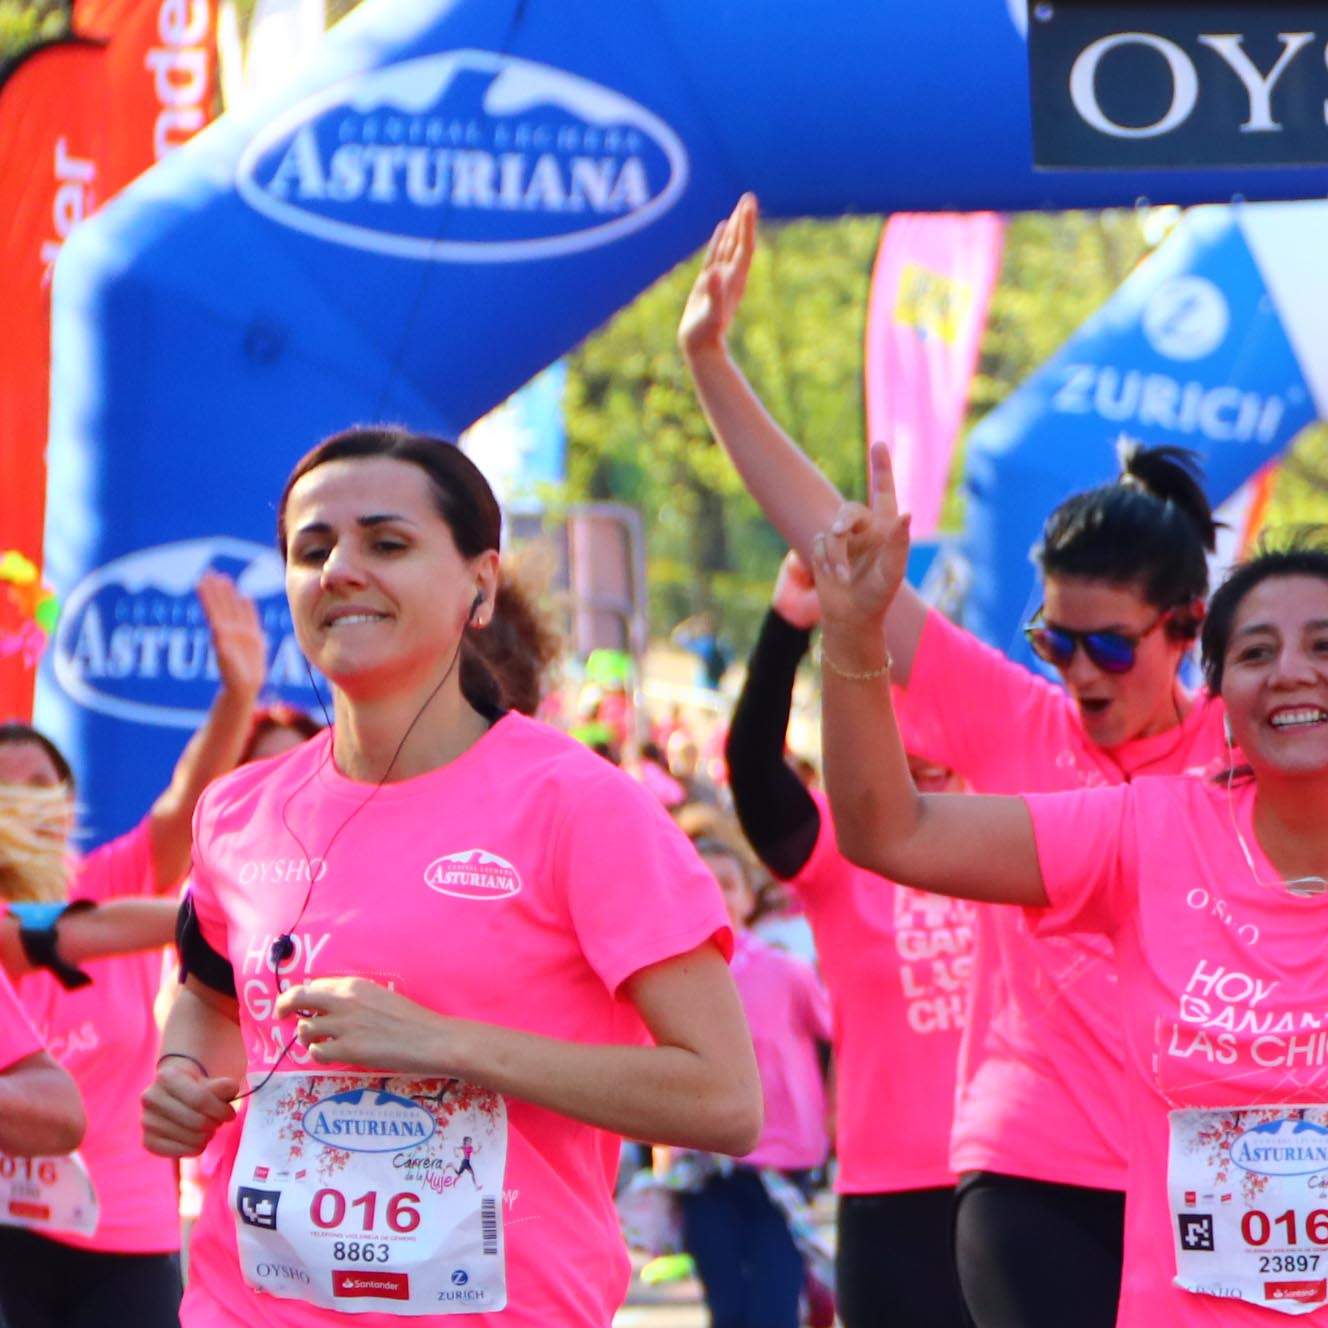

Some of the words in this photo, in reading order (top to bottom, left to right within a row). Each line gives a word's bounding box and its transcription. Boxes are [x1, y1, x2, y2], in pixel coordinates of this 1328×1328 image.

[266, 119, 651, 214] ASTURIANA
[1053, 362, 1286, 445] ZURICH
[239, 857, 328, 885] OYSHO
[429, 864, 515, 891] ASTURIANA
[1184, 960, 1279, 1009] HOY
[1168, 1023, 1238, 1066] LAS
[313, 1111, 426, 1137] ASTURIANA
[309, 1187, 422, 1234] 016
[333, 1241, 390, 1263] 8863
[1259, 1254, 1321, 1274] 23897
[256, 1263, 311, 1285] OYSHO
[354, 1278, 399, 1292] Santander
[437, 1289, 485, 1301] ZURICH
